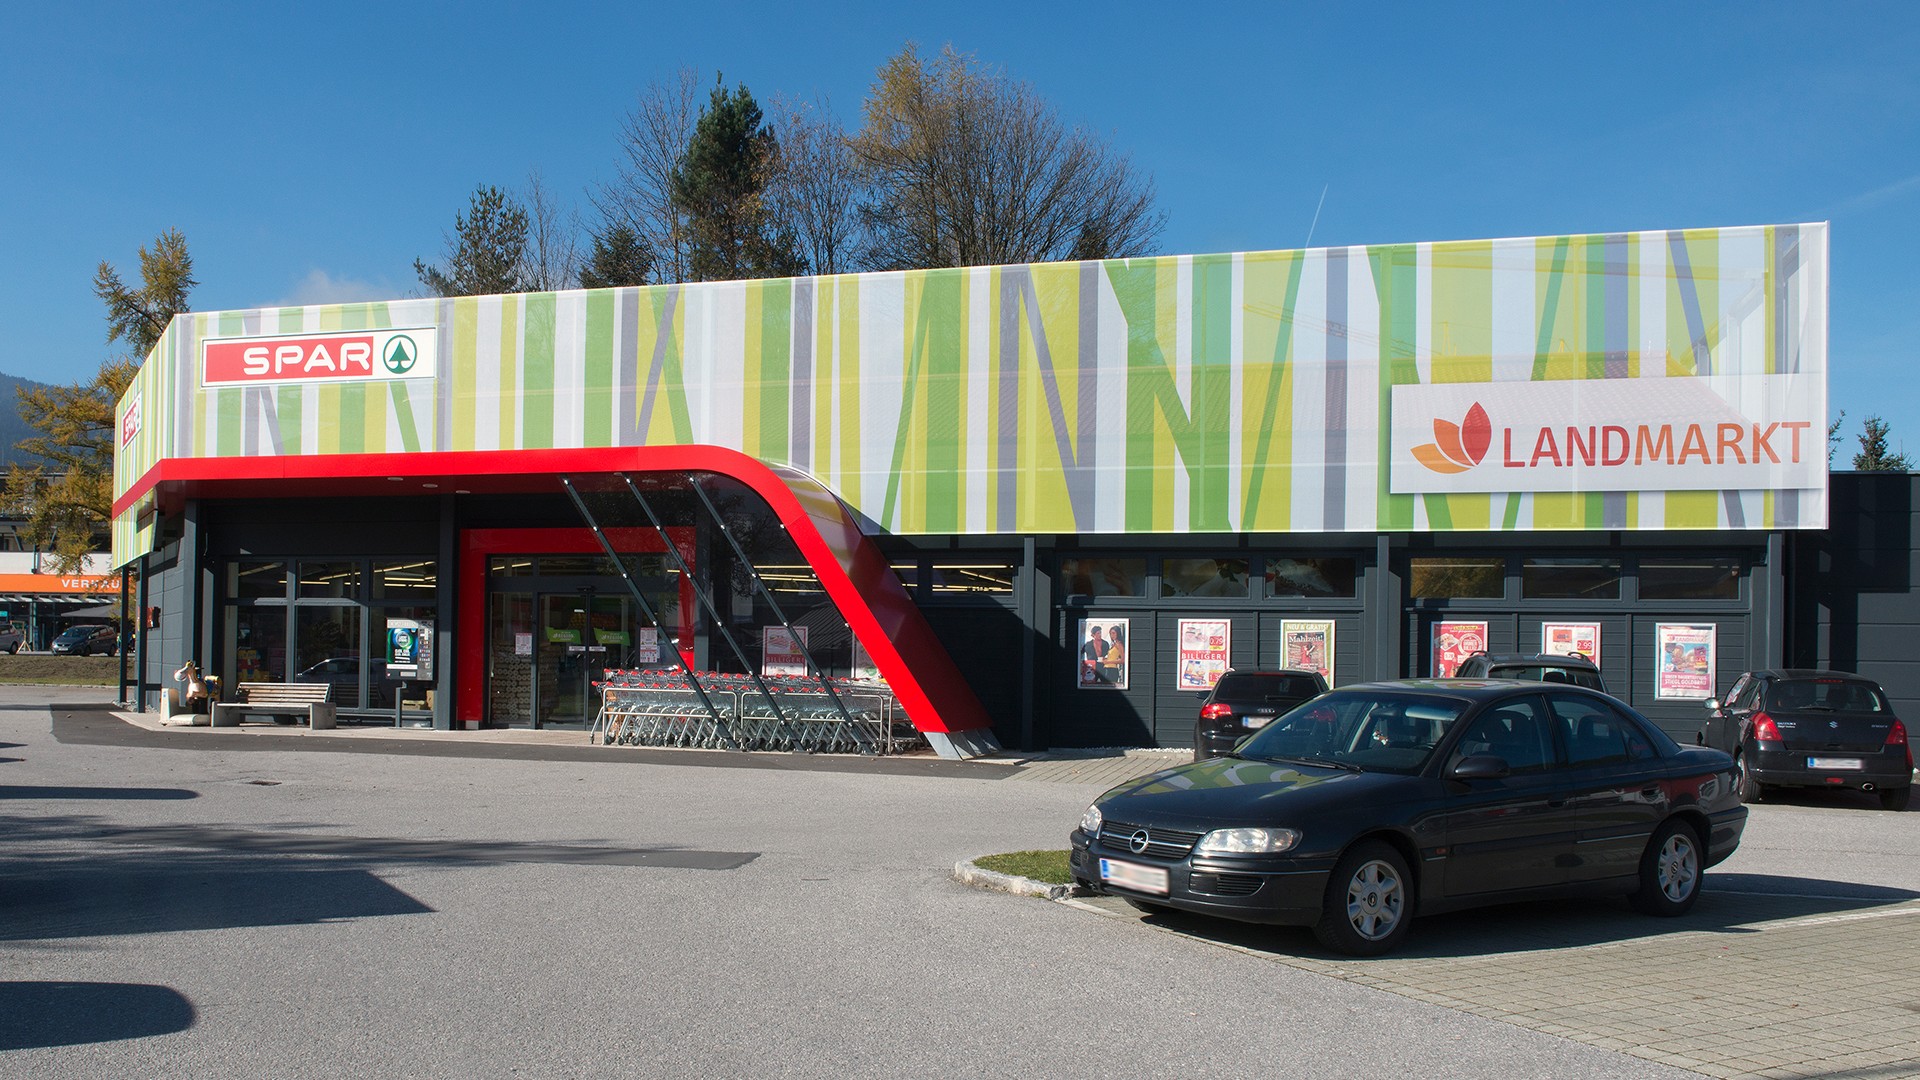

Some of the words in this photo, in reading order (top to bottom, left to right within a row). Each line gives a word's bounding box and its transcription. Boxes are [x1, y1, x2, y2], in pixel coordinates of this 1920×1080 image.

[243, 342, 371, 376] SPAR
[1503, 421, 1811, 468] LANDMARKT
[1181, 652, 1226, 660] BILLIGER!
